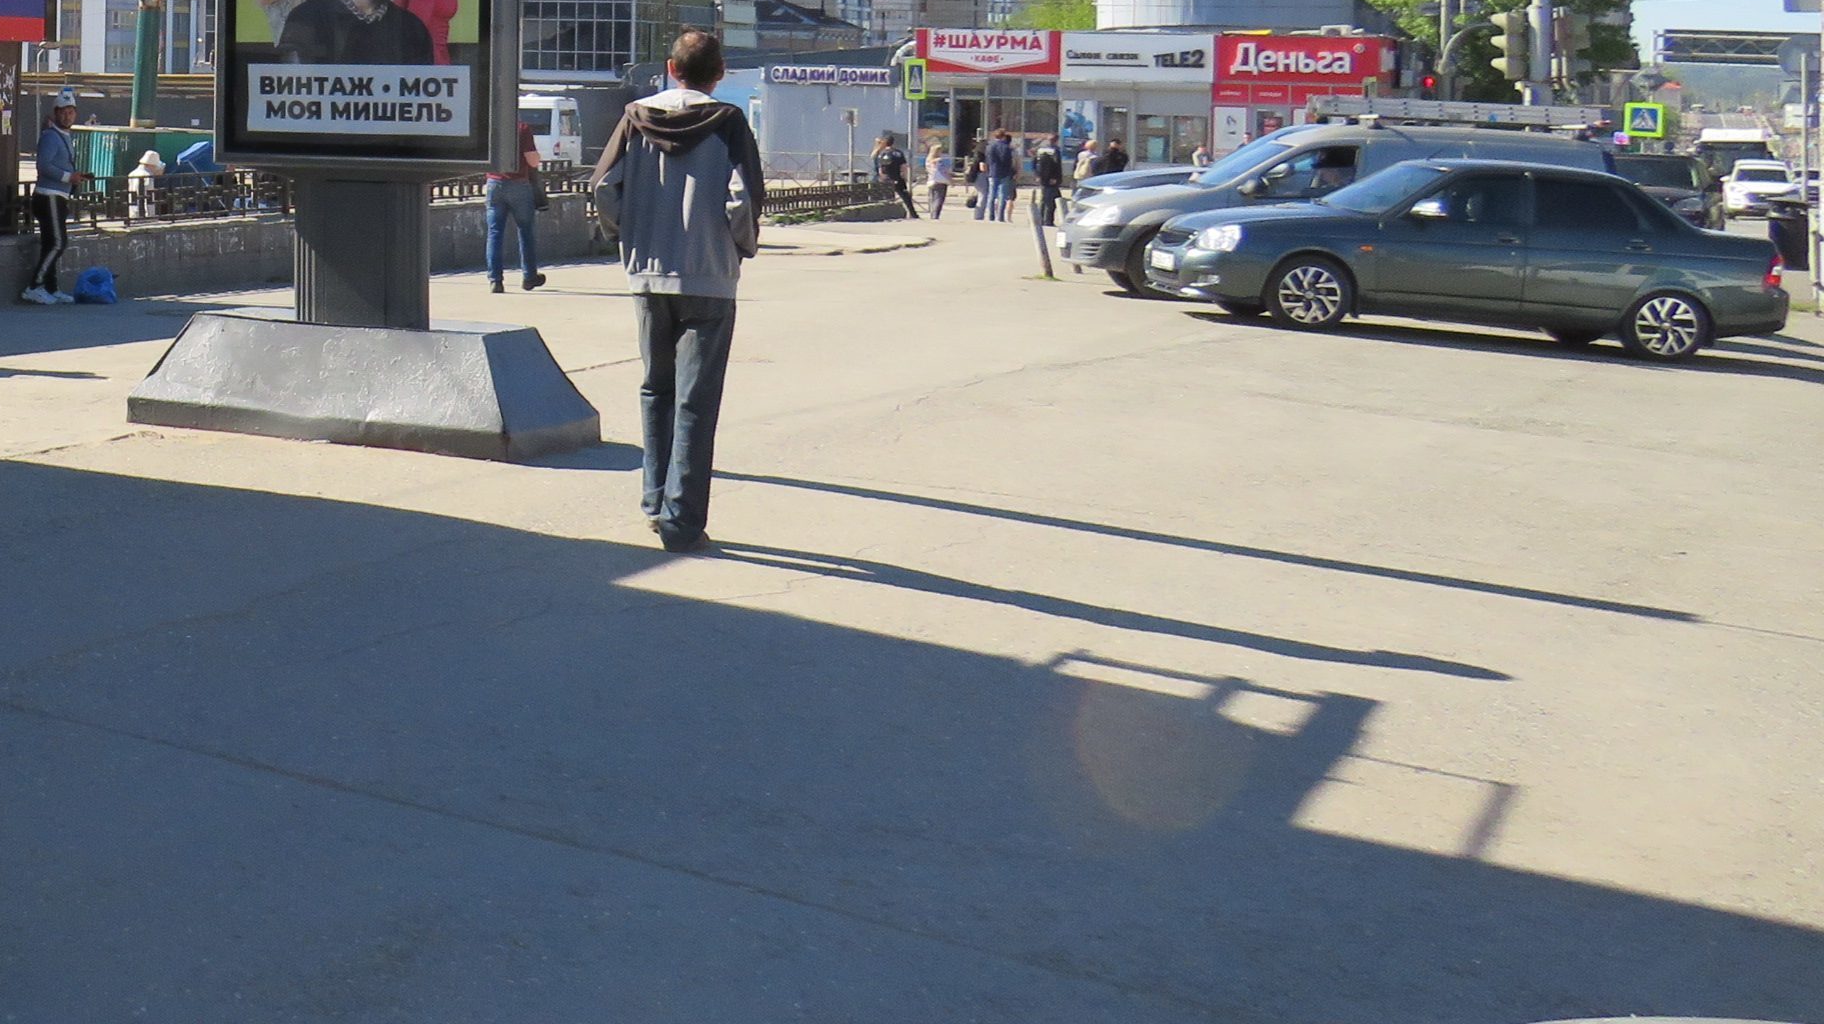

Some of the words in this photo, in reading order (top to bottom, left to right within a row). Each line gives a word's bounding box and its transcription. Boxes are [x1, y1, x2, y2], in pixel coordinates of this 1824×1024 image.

[933, 32, 1042, 51] #ШАУРМА
[974, 55, 999, 63] КАФЕ
[1153, 49, 1205, 68] TELE2
[1230, 42, 1351, 75] Деньга
[771, 65, 836, 84] СЛАДКИЙ
[838, 67, 889, 85] ДОМИК
[259, 75, 374, 96] ВИНТАЖ
[399, 77, 458, 97] МОТ
[265, 100, 322, 120] МОЯ
[330, 101, 453, 123] МИШЕЛЬ
